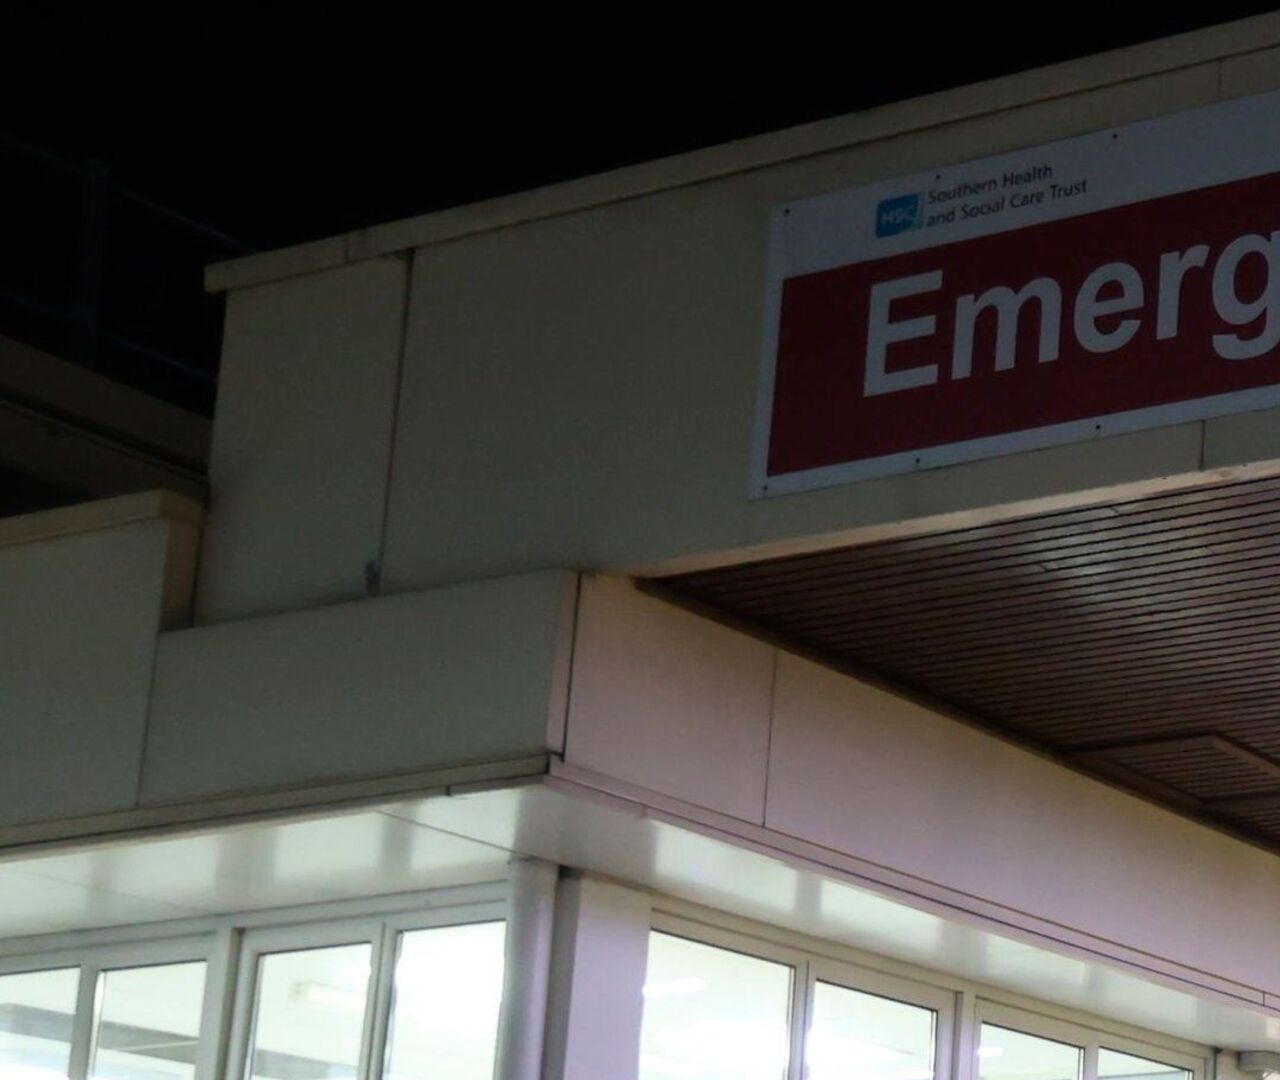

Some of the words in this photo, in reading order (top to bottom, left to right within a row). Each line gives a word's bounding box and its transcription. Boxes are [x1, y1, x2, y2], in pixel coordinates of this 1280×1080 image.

[927, 207, 956, 228] and
[960, 196, 1005, 221] Social
[1010, 190, 1045, 209] Care
[1049, 179, 1088, 200] Trust
[928, 179, 998, 204] Southern
[1002, 165, 1053, 187] Health
[880, 204, 915, 225] HSC
